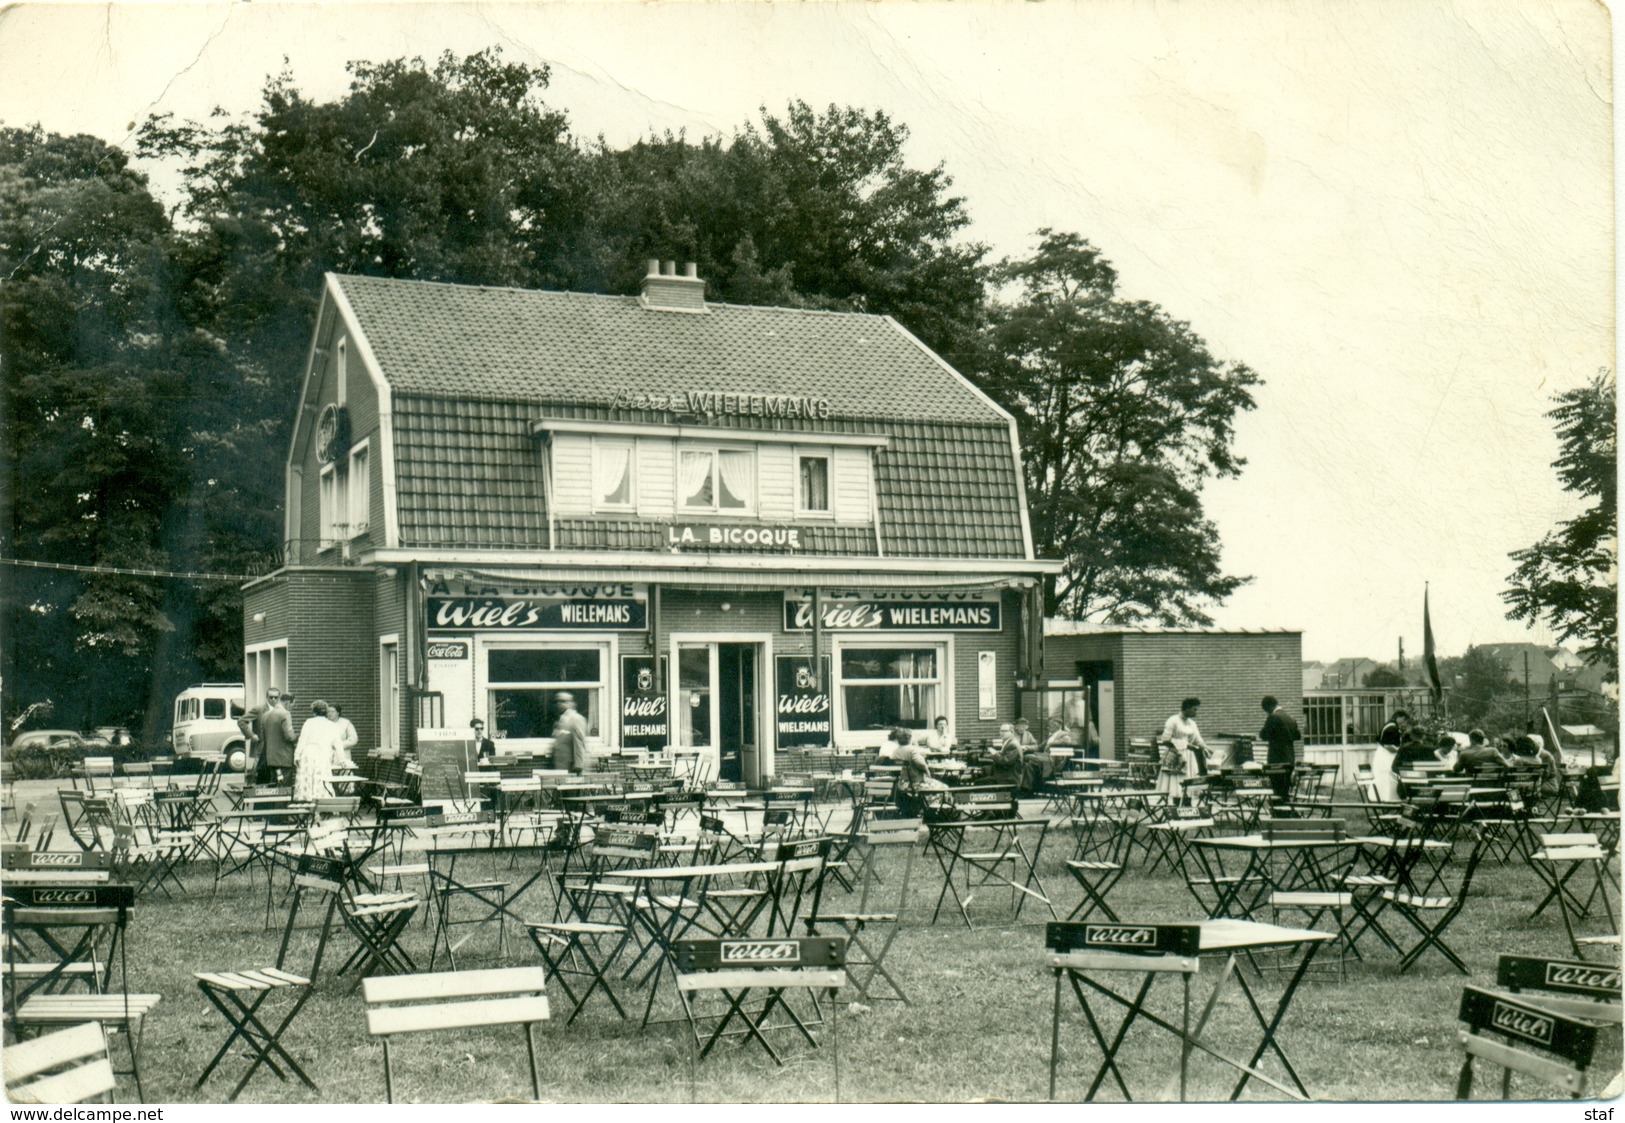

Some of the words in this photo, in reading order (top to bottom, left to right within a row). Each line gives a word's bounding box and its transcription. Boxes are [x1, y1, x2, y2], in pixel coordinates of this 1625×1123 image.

[688, 391, 829, 419] WIELEMANS
[669, 527, 696, 543] LA
[709, 527, 801, 548] BICOQUE
[436, 600, 540, 627] Wiel's
[560, 604, 630, 624] WIELEMANS
[890, 606, 991, 625] WIELEMANS
[624, 696, 667, 717] Wiel's
[779, 693, 829, 714] Wiel's
[624, 723, 667, 737] WIELEMANS
[778, 720, 829, 734] WIELEMANS
[1090, 927, 1151, 943] Wiel's
[728, 943, 794, 959] Wiel's
